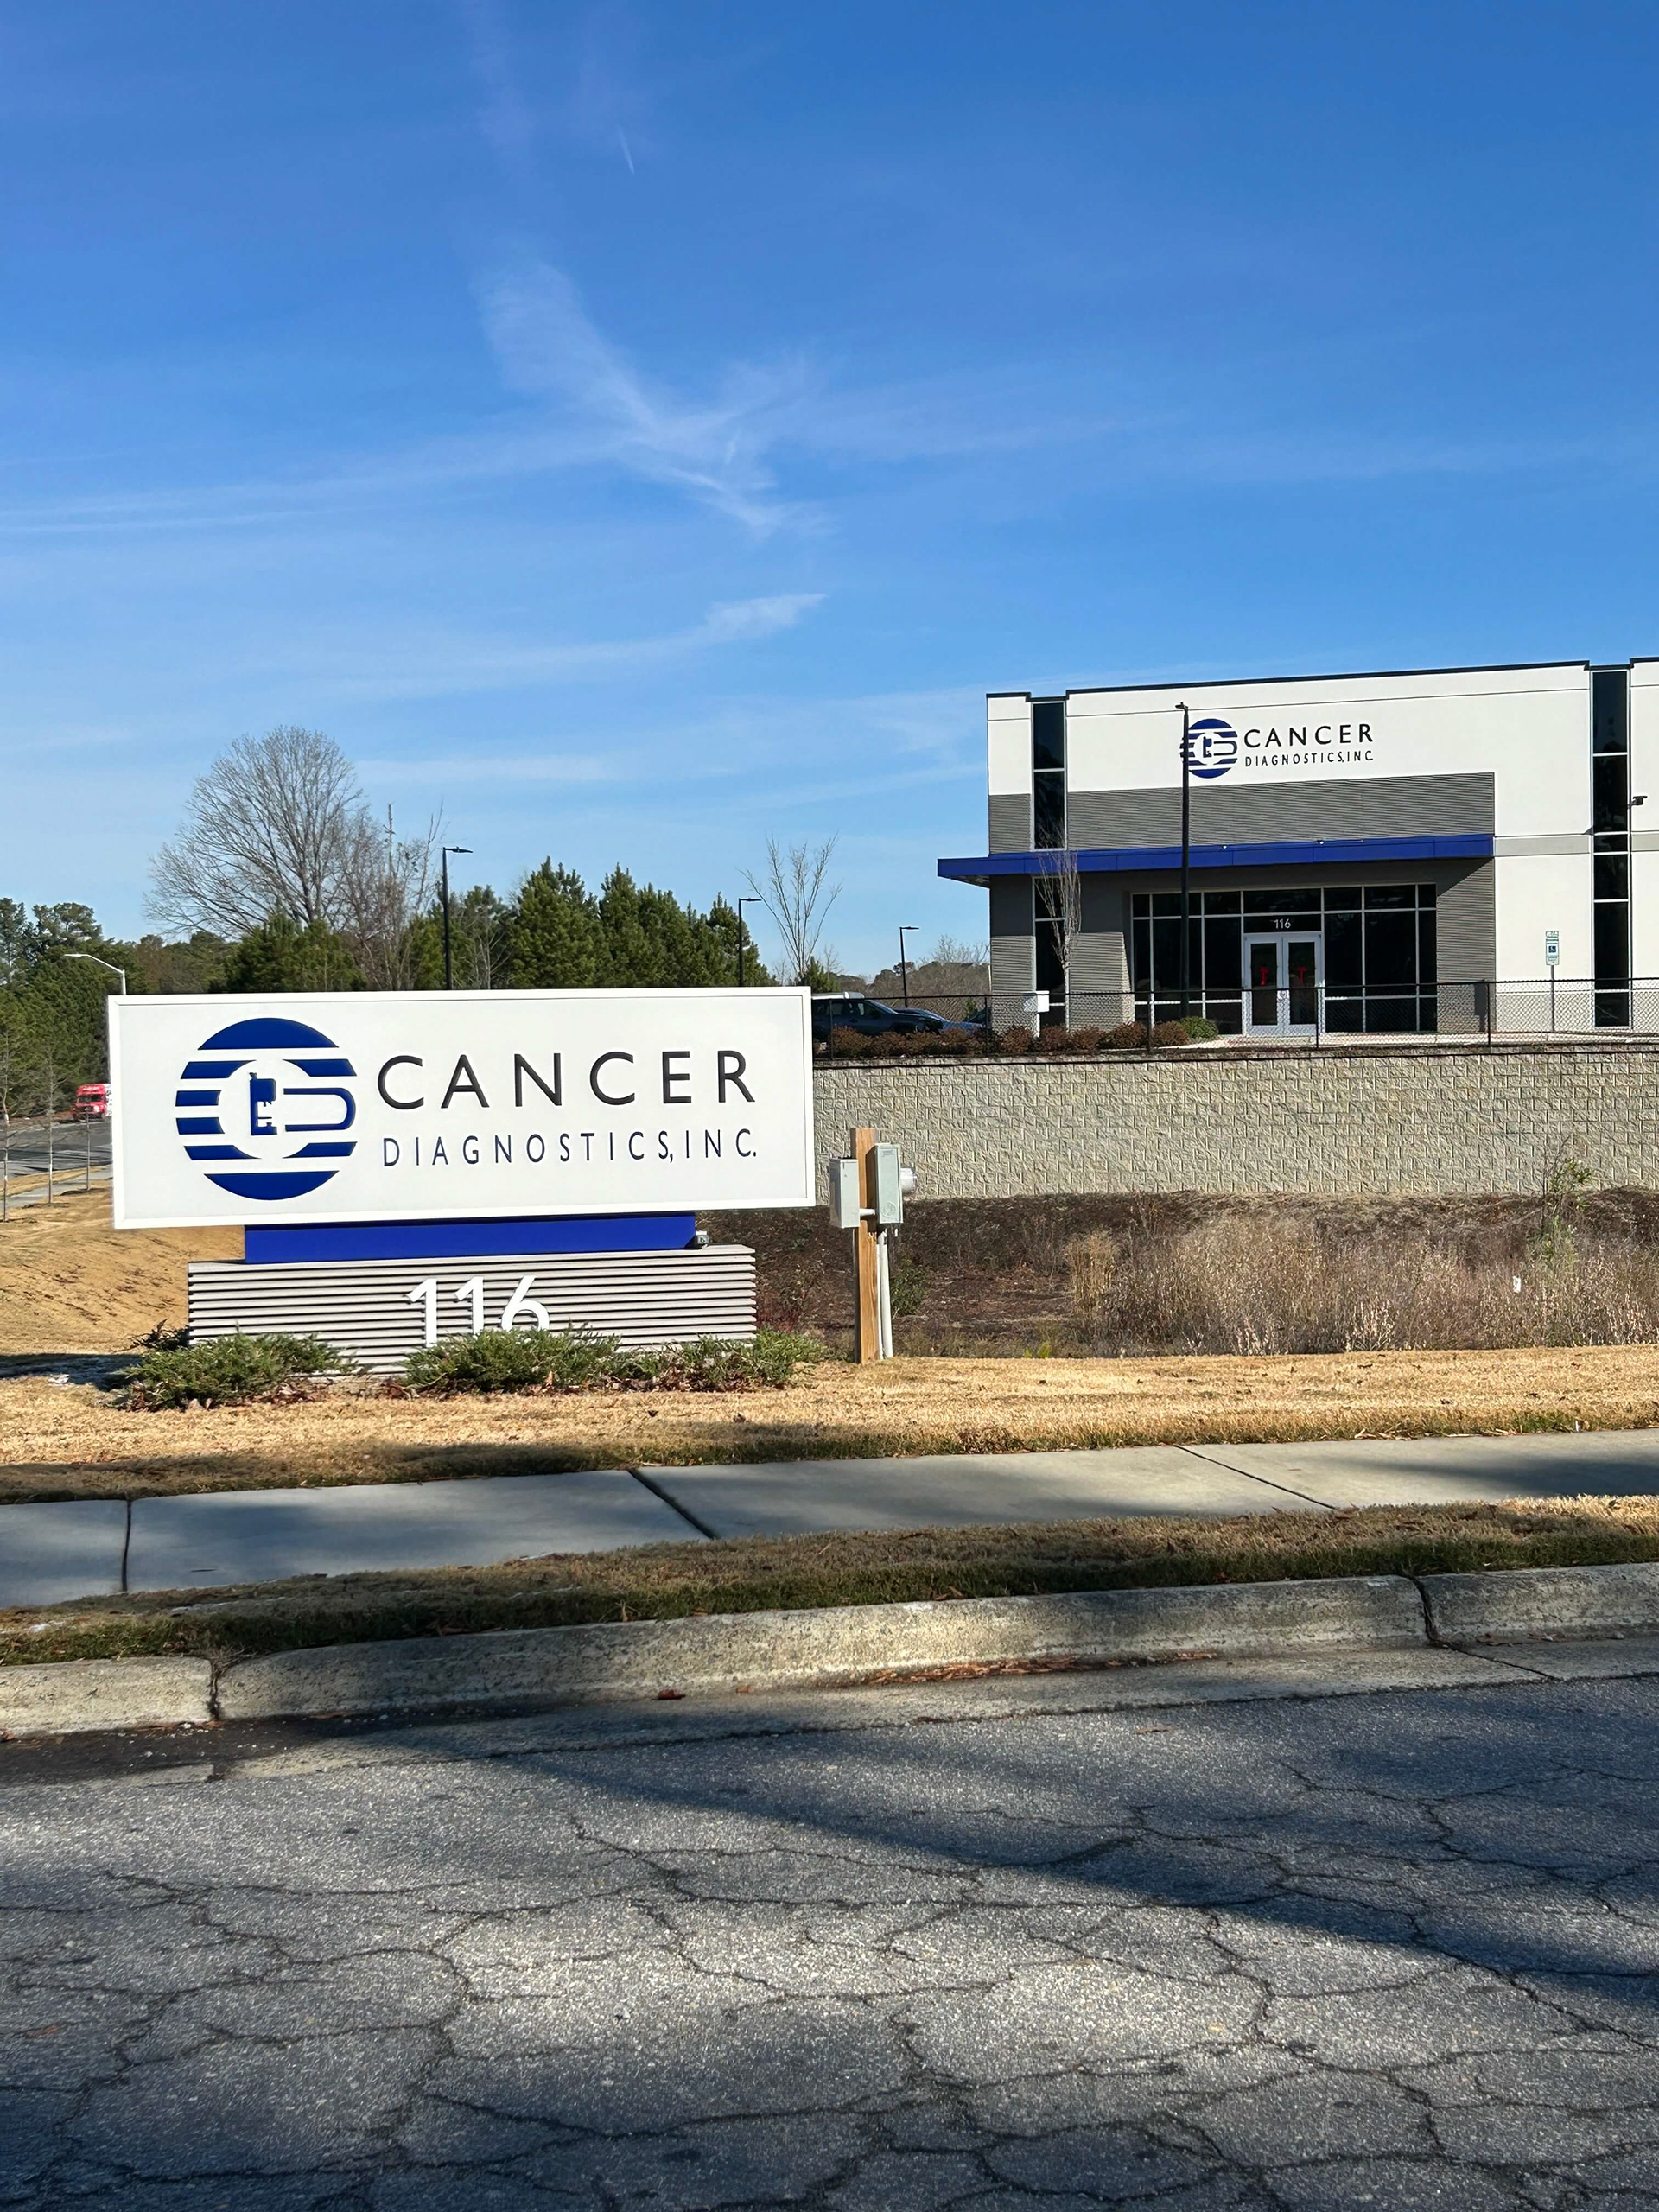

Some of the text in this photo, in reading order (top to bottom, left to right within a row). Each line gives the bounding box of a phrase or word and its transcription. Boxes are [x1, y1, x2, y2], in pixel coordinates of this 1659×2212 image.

[1243, 723, 1374, 748] CANCER
[1274, 918, 1292, 929] 116
[377, 1050, 756, 1110] CANCER
[405, 1274, 550, 1348] 116
